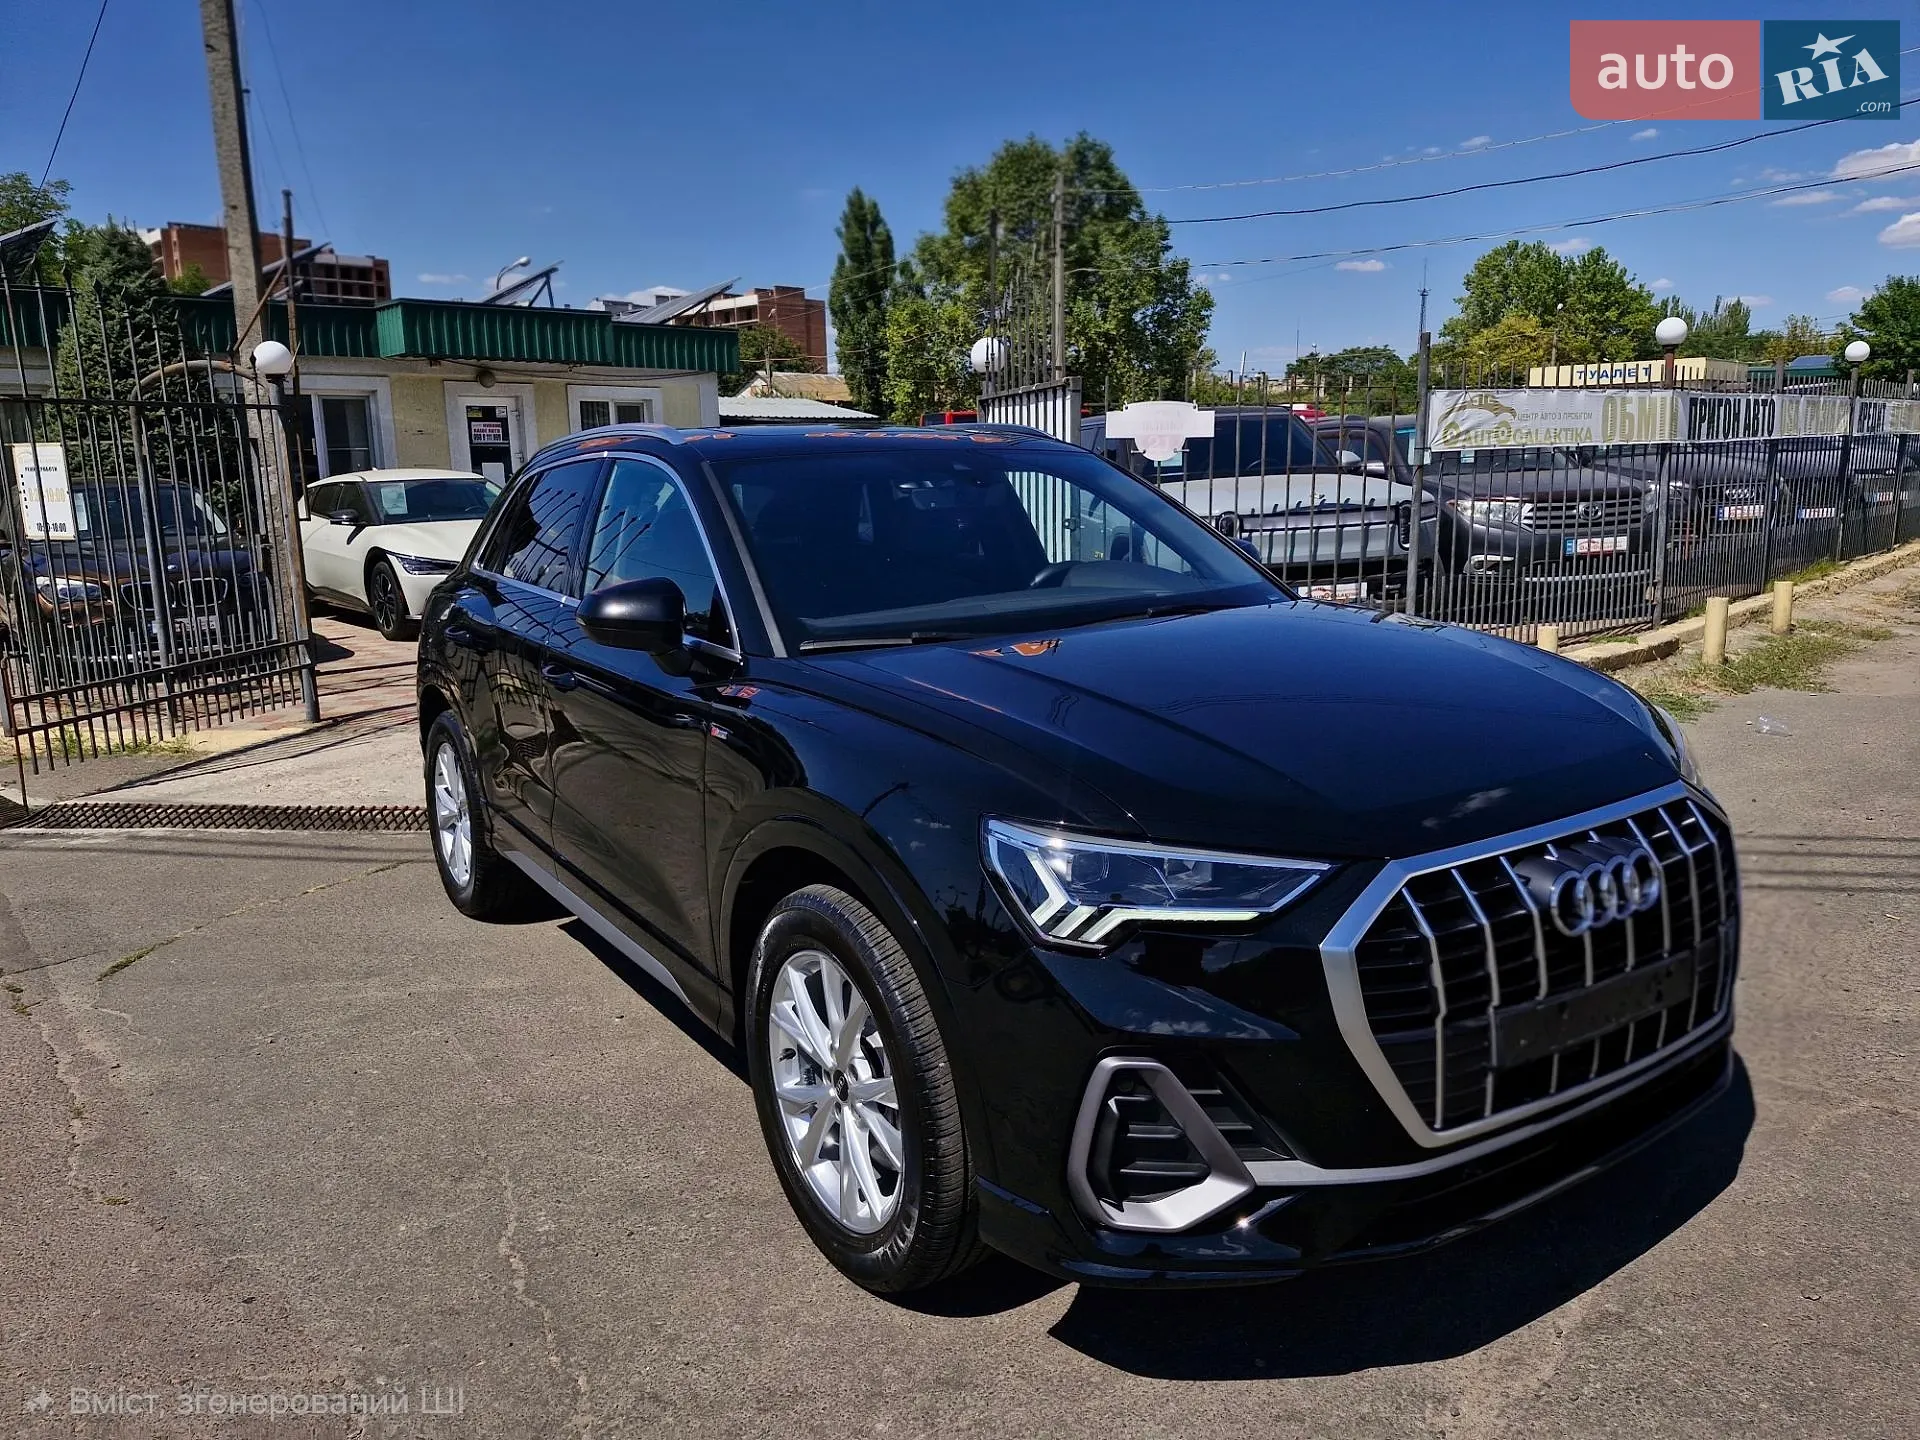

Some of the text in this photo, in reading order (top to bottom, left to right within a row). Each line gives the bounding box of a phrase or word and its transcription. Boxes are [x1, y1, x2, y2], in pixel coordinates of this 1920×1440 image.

[1576, 367, 1650, 380] ТУАЛЕТ
[1540, 412, 1557, 421] АВТО
[1687, 397, 1741, 441] ПРИГОН
[1742, 398, 1776, 438] АВТО
